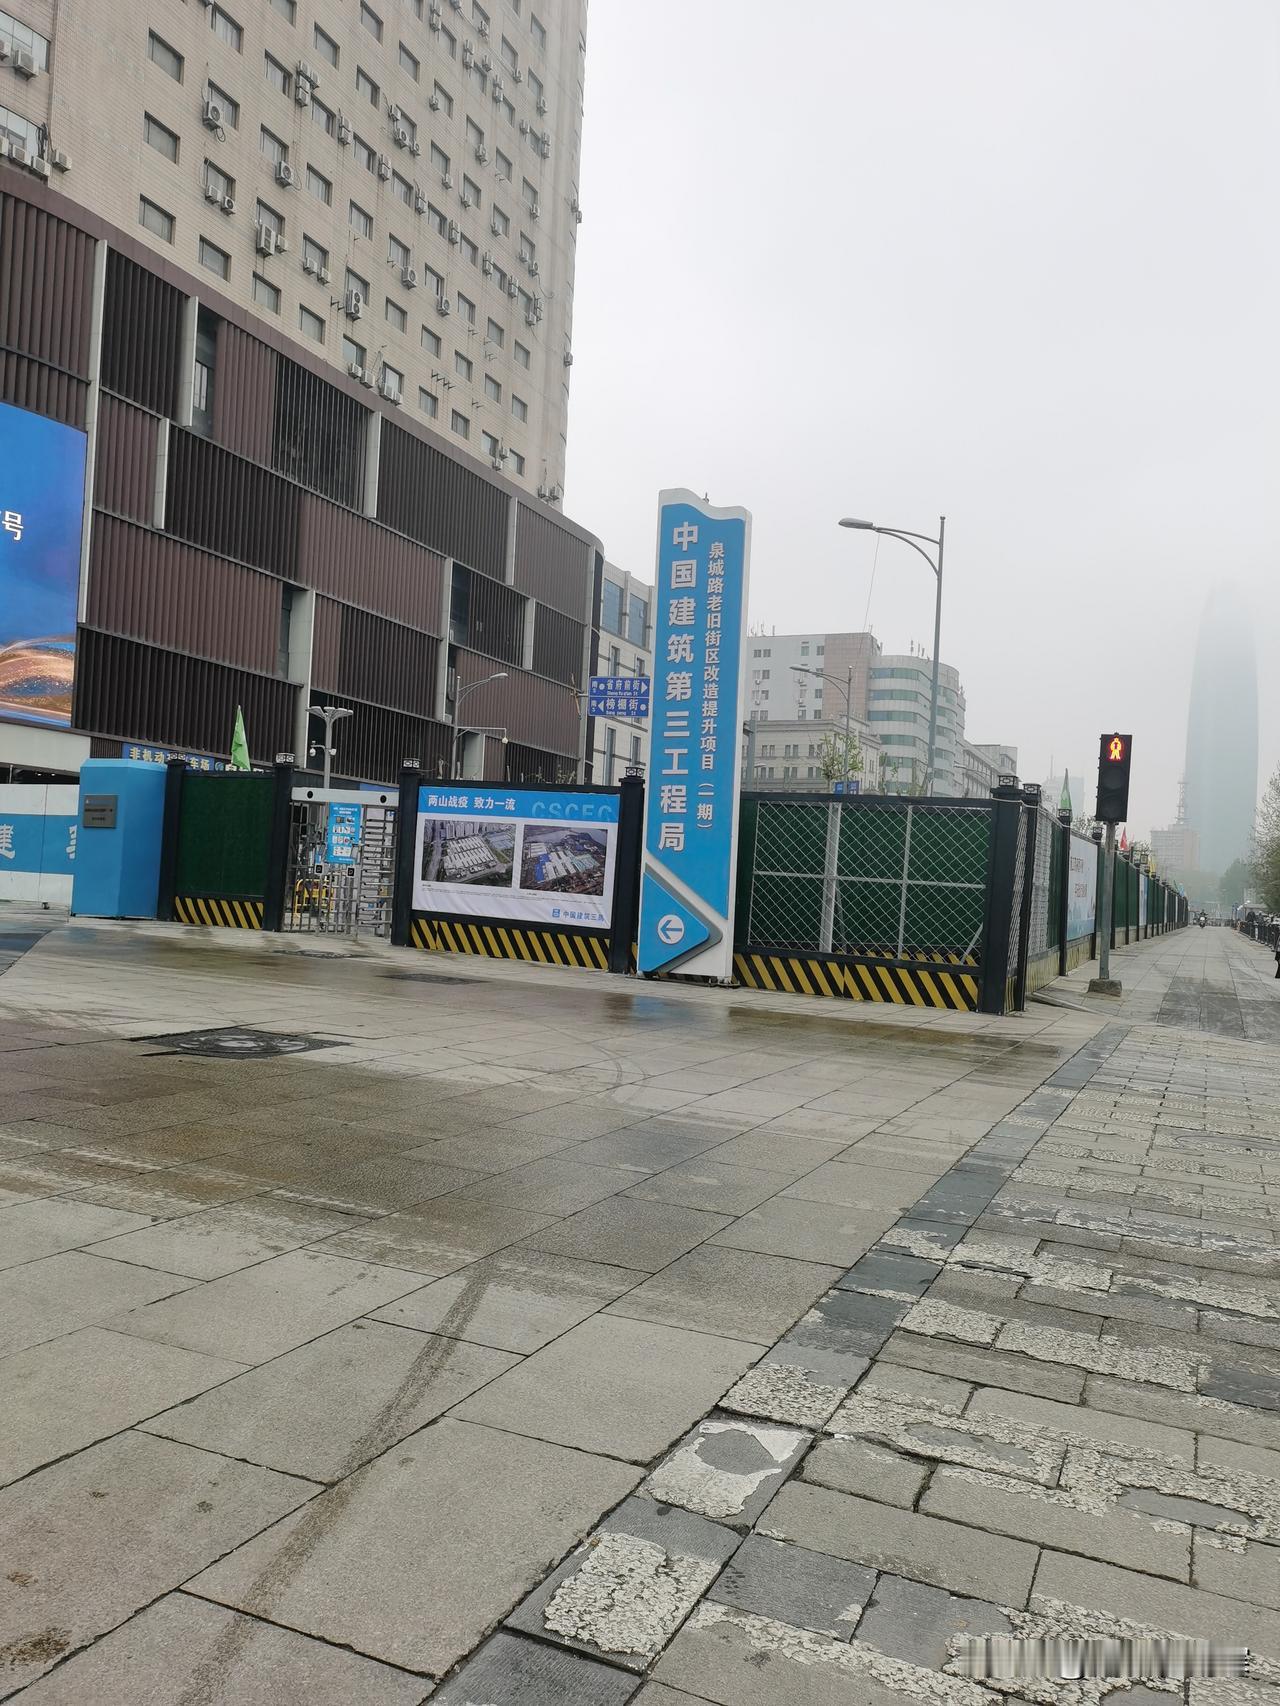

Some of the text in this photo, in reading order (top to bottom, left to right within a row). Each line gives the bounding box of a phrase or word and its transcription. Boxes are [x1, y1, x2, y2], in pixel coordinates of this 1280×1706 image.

[607, 679, 640, 691] 省府前街
[658, 521, 699, 852] 中国建筑第三工程局
[129, 747, 210, 771] 非机动车场
[428, 794, 516, 811] 两山战疫 致力一流
